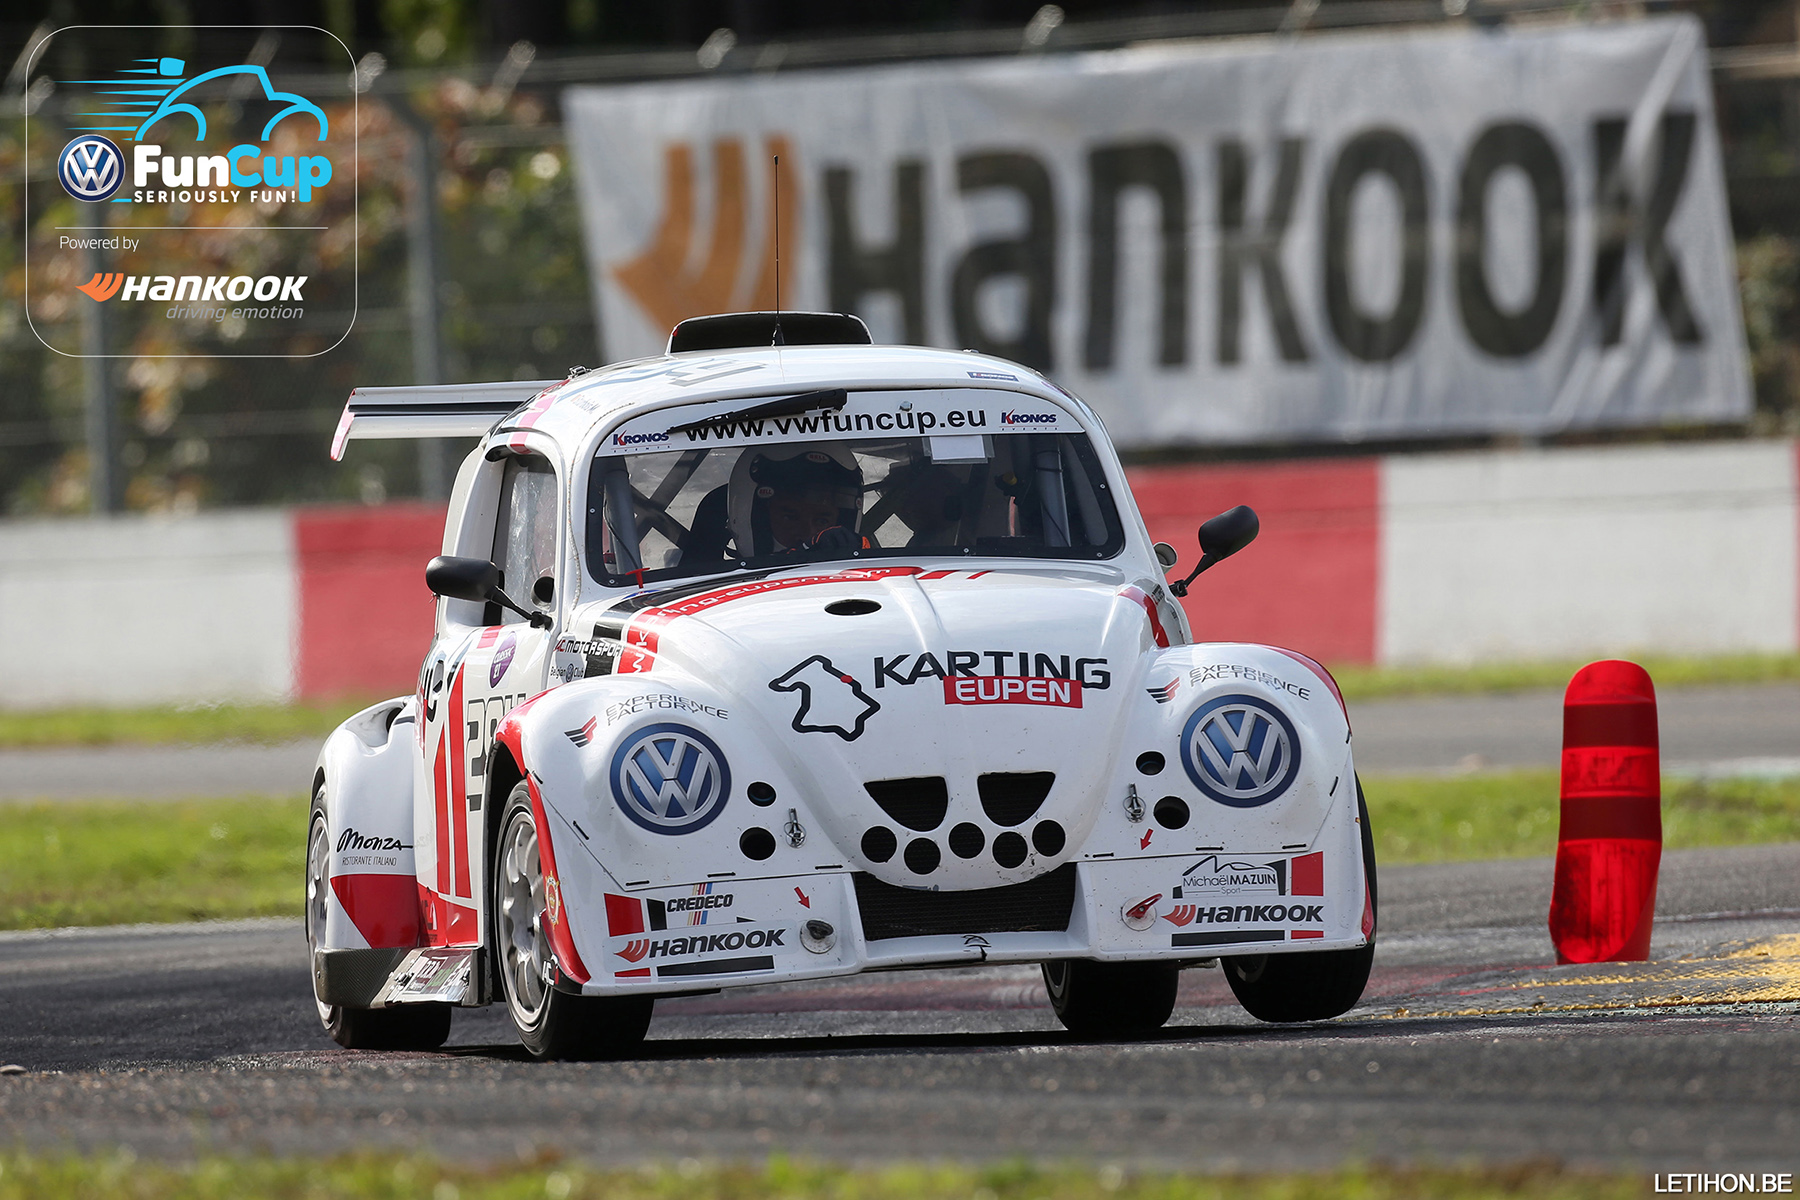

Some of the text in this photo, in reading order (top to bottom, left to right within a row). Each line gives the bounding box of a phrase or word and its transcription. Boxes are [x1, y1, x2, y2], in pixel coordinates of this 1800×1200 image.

[685, 409, 987, 441] www.vwfuncup.eu
[1001, 409, 1057, 424] KRONOS
[612, 430, 669, 446] KRONOS
[873, 650, 1111, 690] KARTING
[1190, 670, 1281, 690] FACTORY
[955, 678, 1071, 704] EUPEN
[1189, 663, 1311, 701] EXPERIENCE
[606, 693, 729, 720] EXPERIENCE
[607, 700, 699, 726] FACTORY
[342, 855, 397, 867] RISTORANTE ITALIANO
[1221, 886, 1242, 896] Sport
[666, 893, 734, 913] CREDECO
